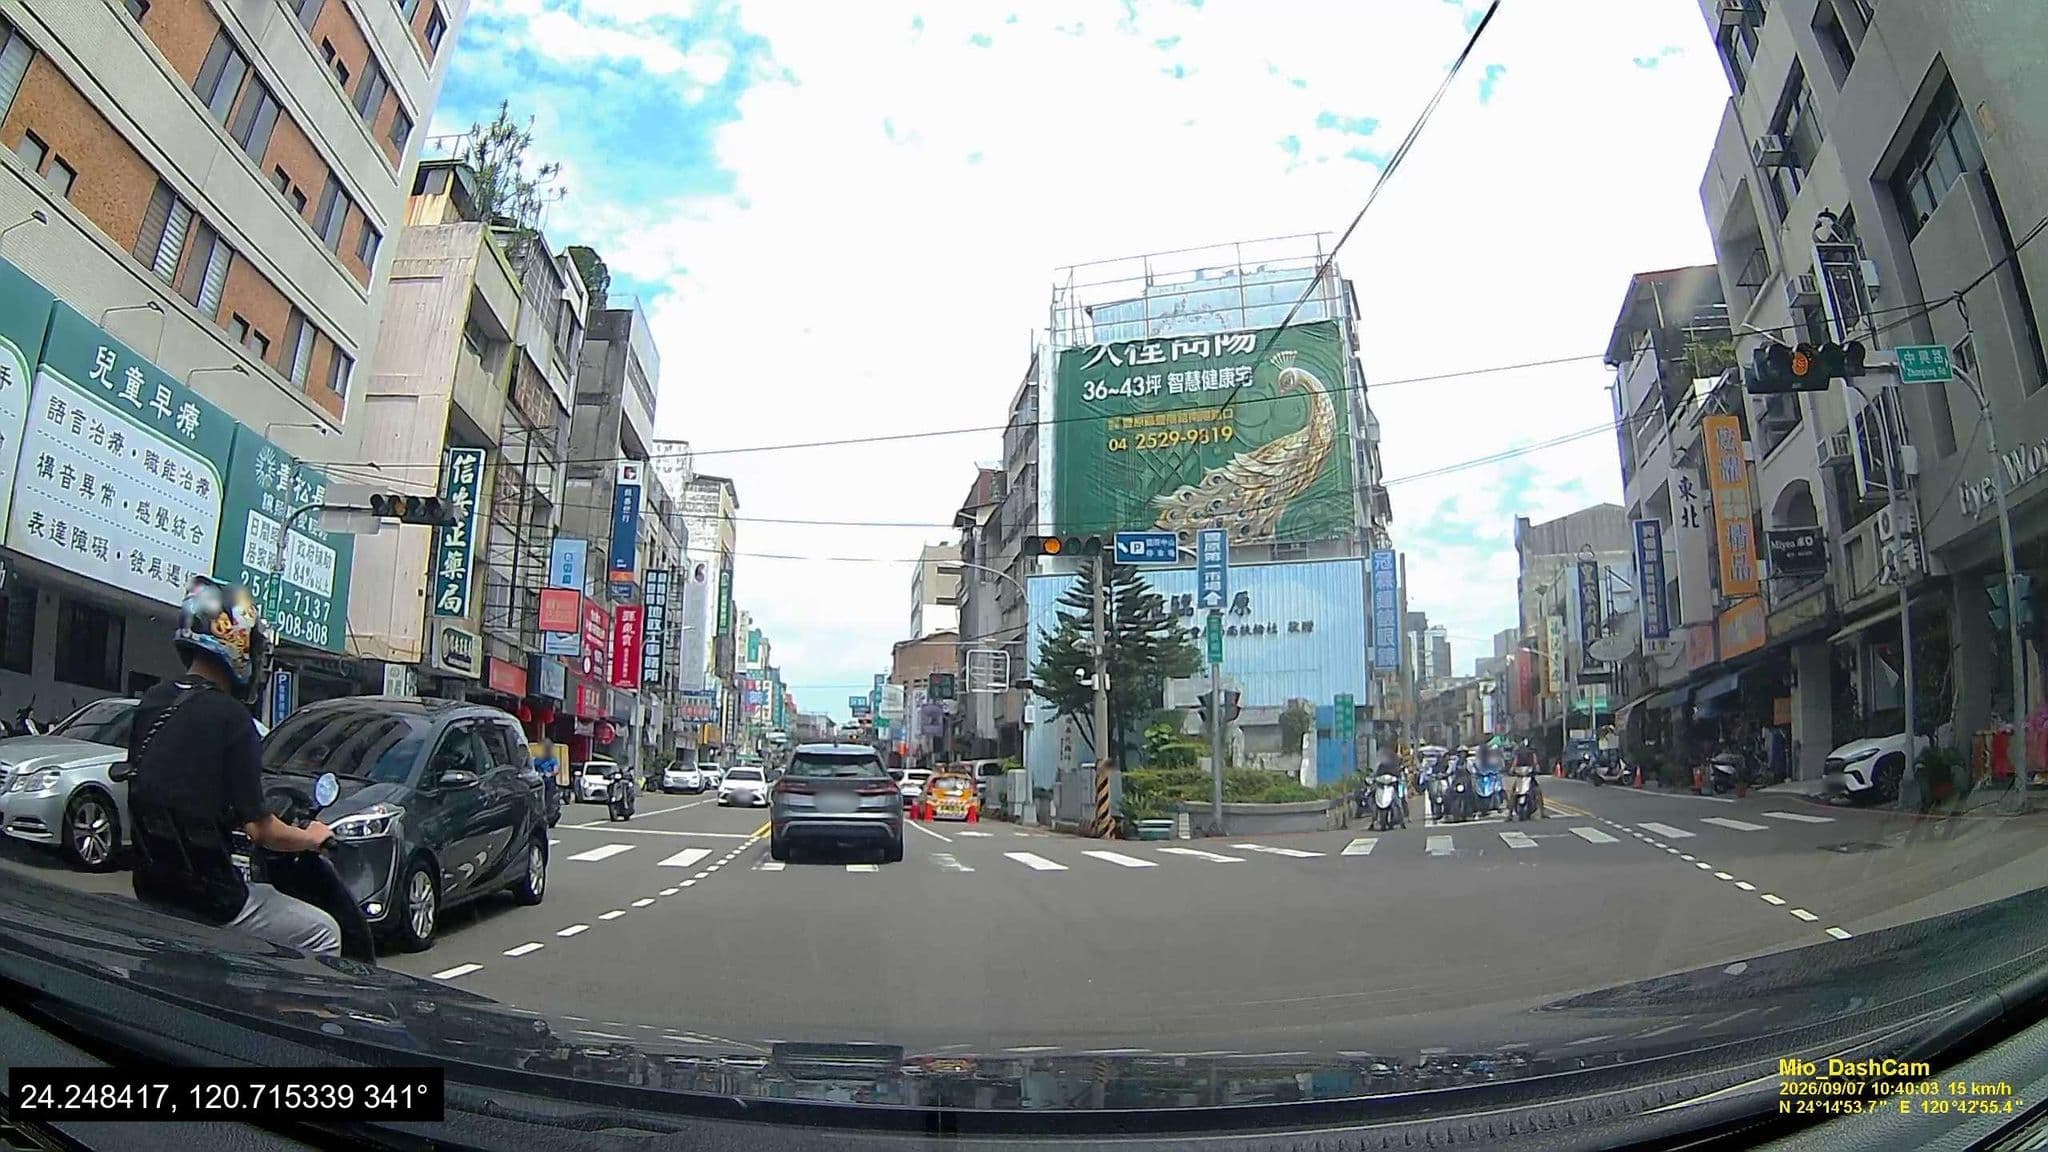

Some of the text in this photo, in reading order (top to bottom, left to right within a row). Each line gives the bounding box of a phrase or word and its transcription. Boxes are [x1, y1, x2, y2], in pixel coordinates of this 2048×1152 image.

[1904, 350, 1943, 364] 中興路
[89, 345, 201, 440] 兒童早療
[1082, 366, 1253, 401] 36~43坪 智慧健康宅
[1108, 438, 1128, 451] 04
[1678, 475, 1700, 529] 東北
